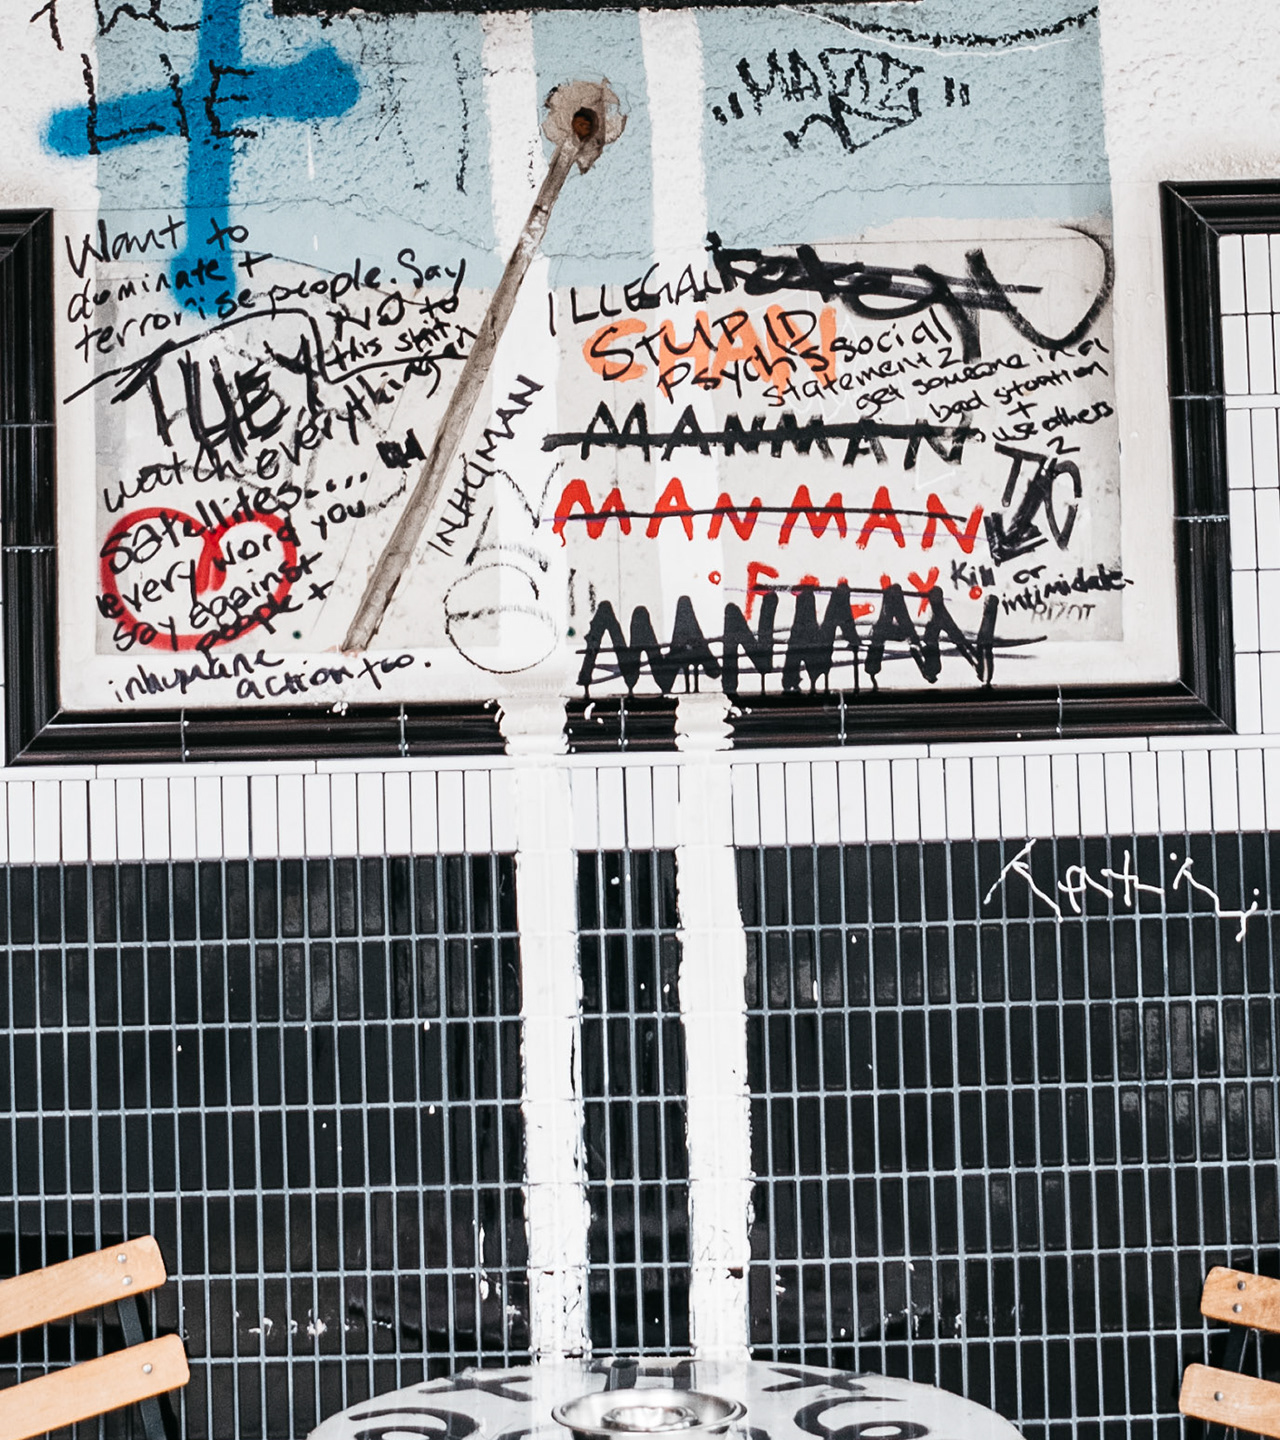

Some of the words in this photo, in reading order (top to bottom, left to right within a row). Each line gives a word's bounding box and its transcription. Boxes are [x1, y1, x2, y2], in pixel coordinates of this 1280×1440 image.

[206, 217, 249, 251] to
[68, 257, 231, 323] dominate
[75, 288, 255, 362] terrorise
[829, 306, 953, 363] social
[762, 351, 933, 407] statement
[856, 382, 906, 417] get
[104, 438, 247, 513] watch
[256, 352, 441, 481] everything
[427, 373, 544, 557] INHUMAN
[552, 476, 984, 555] MANMAN
[96, 558, 199, 618] every
[213, 516, 302, 571] word
[310, 499, 367, 541] you
[189, 551, 322, 630] against
[1012, 565, 1047, 584] or
[236, 660, 355, 701] action
